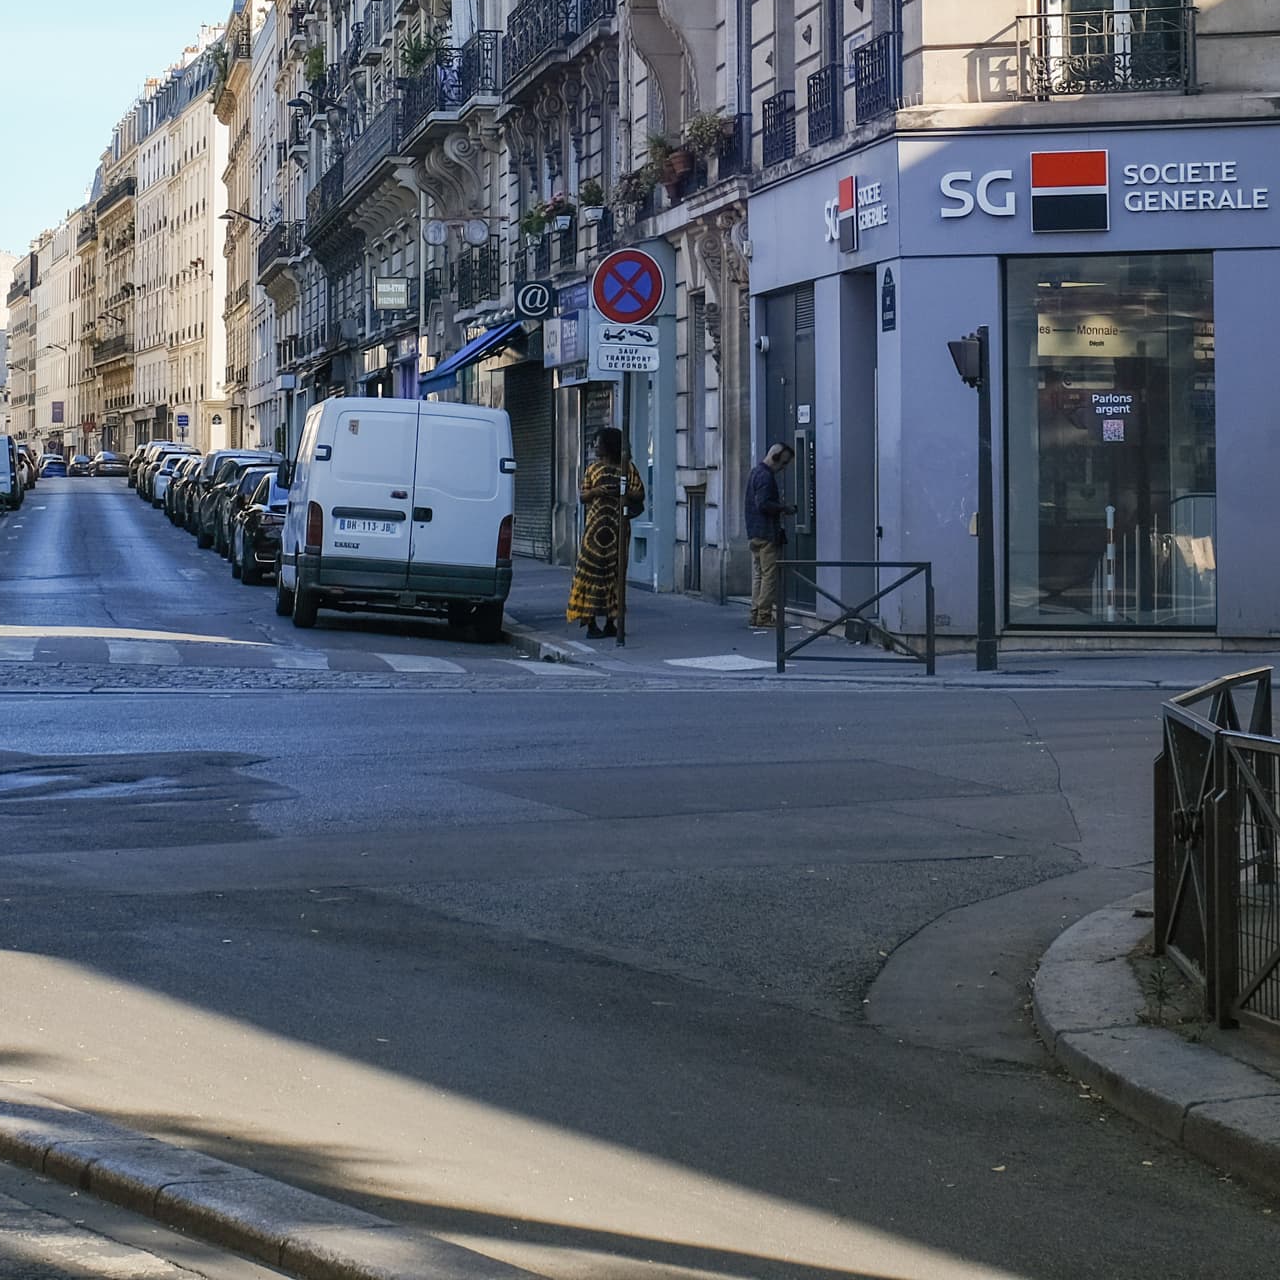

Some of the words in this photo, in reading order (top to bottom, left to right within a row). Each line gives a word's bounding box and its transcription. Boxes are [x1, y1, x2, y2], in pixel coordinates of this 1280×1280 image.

[1123, 161, 1238, 186] SOCIETE
[857, 181, 882, 207] SOCIETE
[940, 169, 1017, 218] SG
[1124, 188, 1270, 213] GENERALE
[858, 204, 889, 231] GENERALE
[1077, 325, 1119, 335] Monnaie
[618, 347, 639, 355] SAUF
[606, 354, 651, 362] TRANSPORT
[621, 362, 648, 370] FONDS
[1091, 393, 1133, 404] Parlons
[1095, 404, 1131, 416] argent
